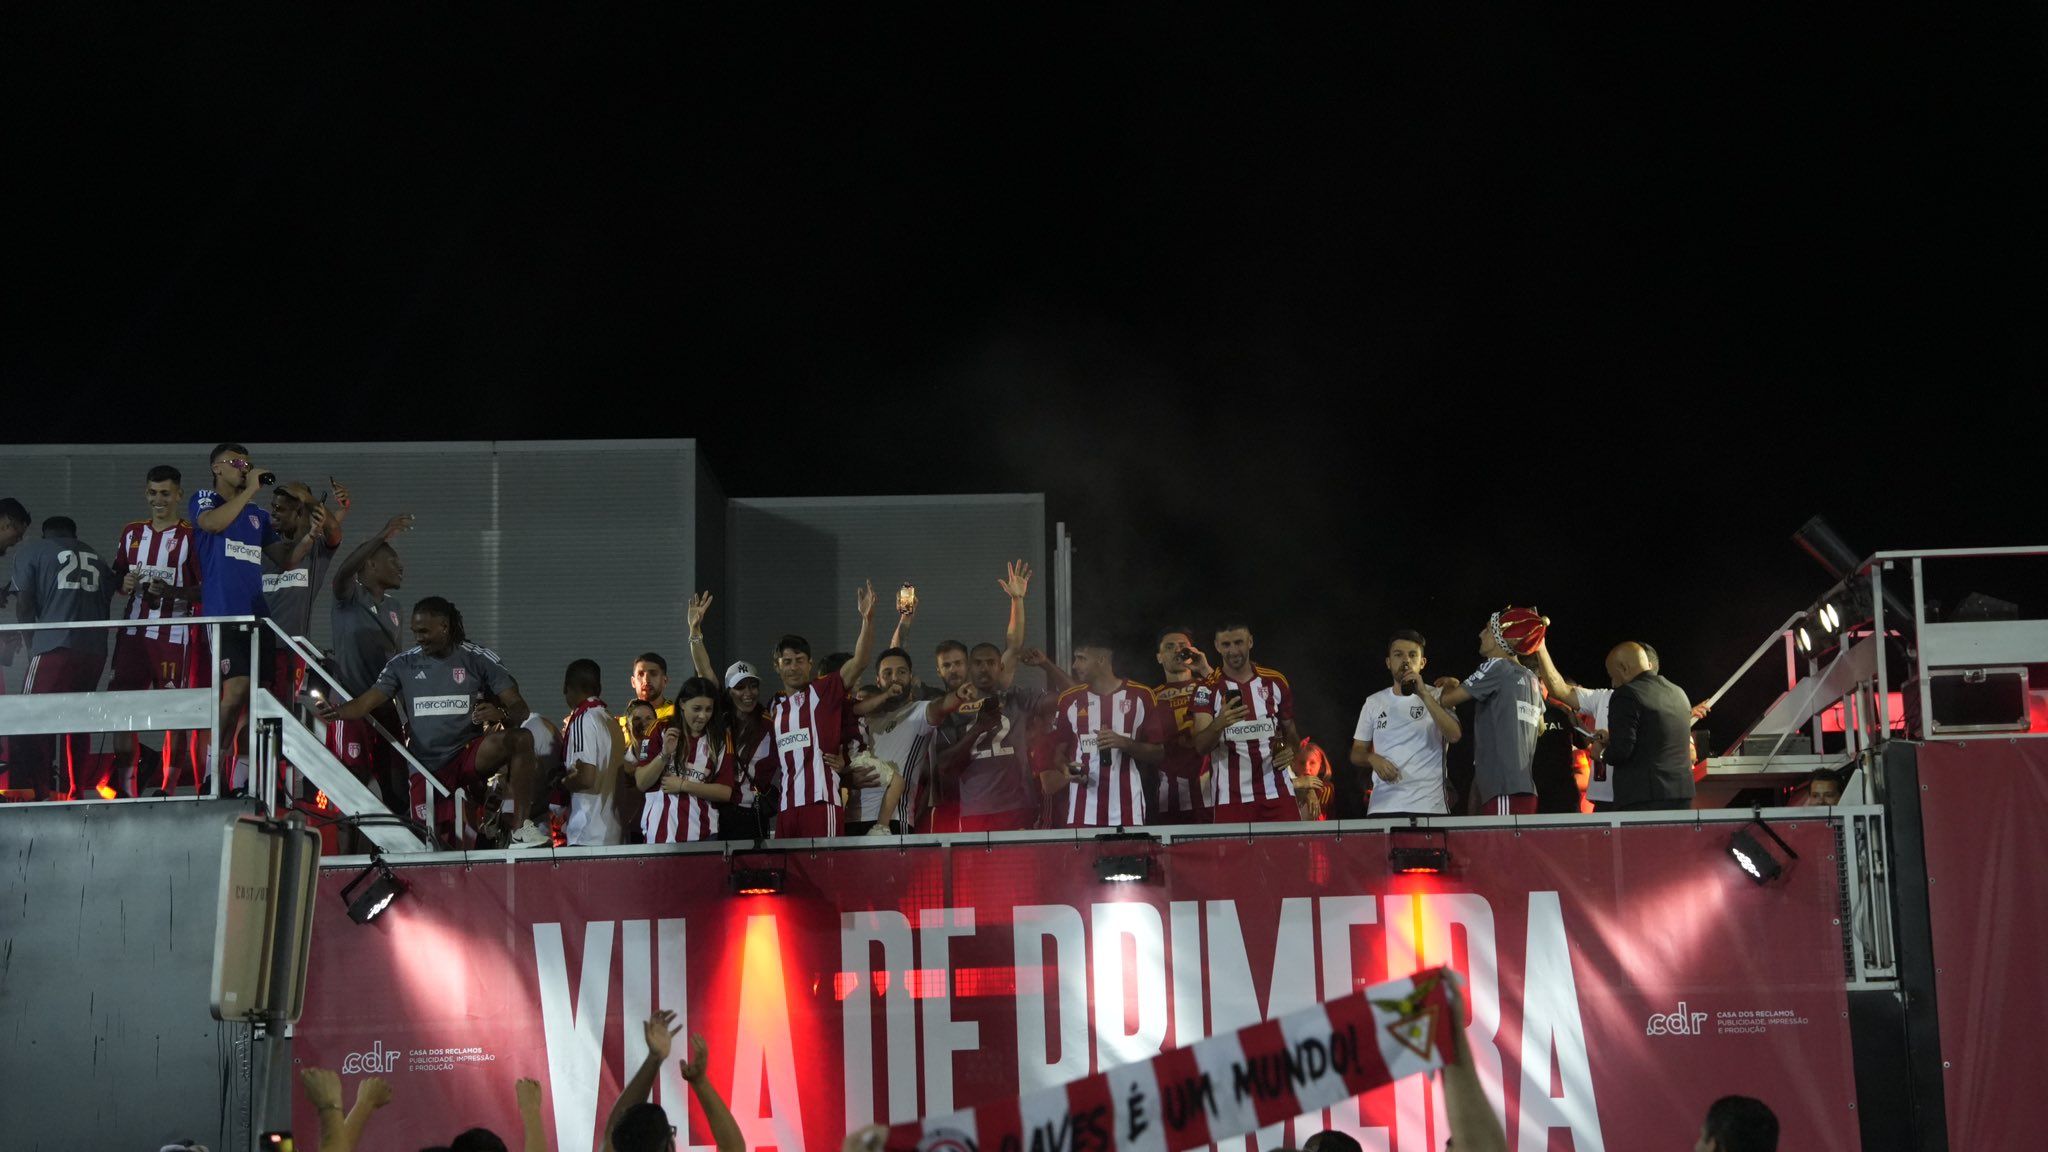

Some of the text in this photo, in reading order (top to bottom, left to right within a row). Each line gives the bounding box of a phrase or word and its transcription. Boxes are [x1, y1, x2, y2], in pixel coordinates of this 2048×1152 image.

[57, 549, 100, 593] 25
[160, 660, 177, 680] 11
[1716, 1009, 1795, 1019] CASA DOS RECLAMOS
[533, 891, 1608, 1152] VILA DE PRIMEIRA
[1768, 1016, 1809, 1025] IMPRESSÃO
[1724, 1025, 1766, 1034] PRODUÇÃO
[456, 1053, 495, 1062] IMPRESSÃO
[415, 1063, 454, 1072] PRODUÇÃO
[1127, 1081, 1148, 1143] É
[1165, 1070, 1219, 1132] UM
[1232, 1024, 1364, 1105] MUNDO!
